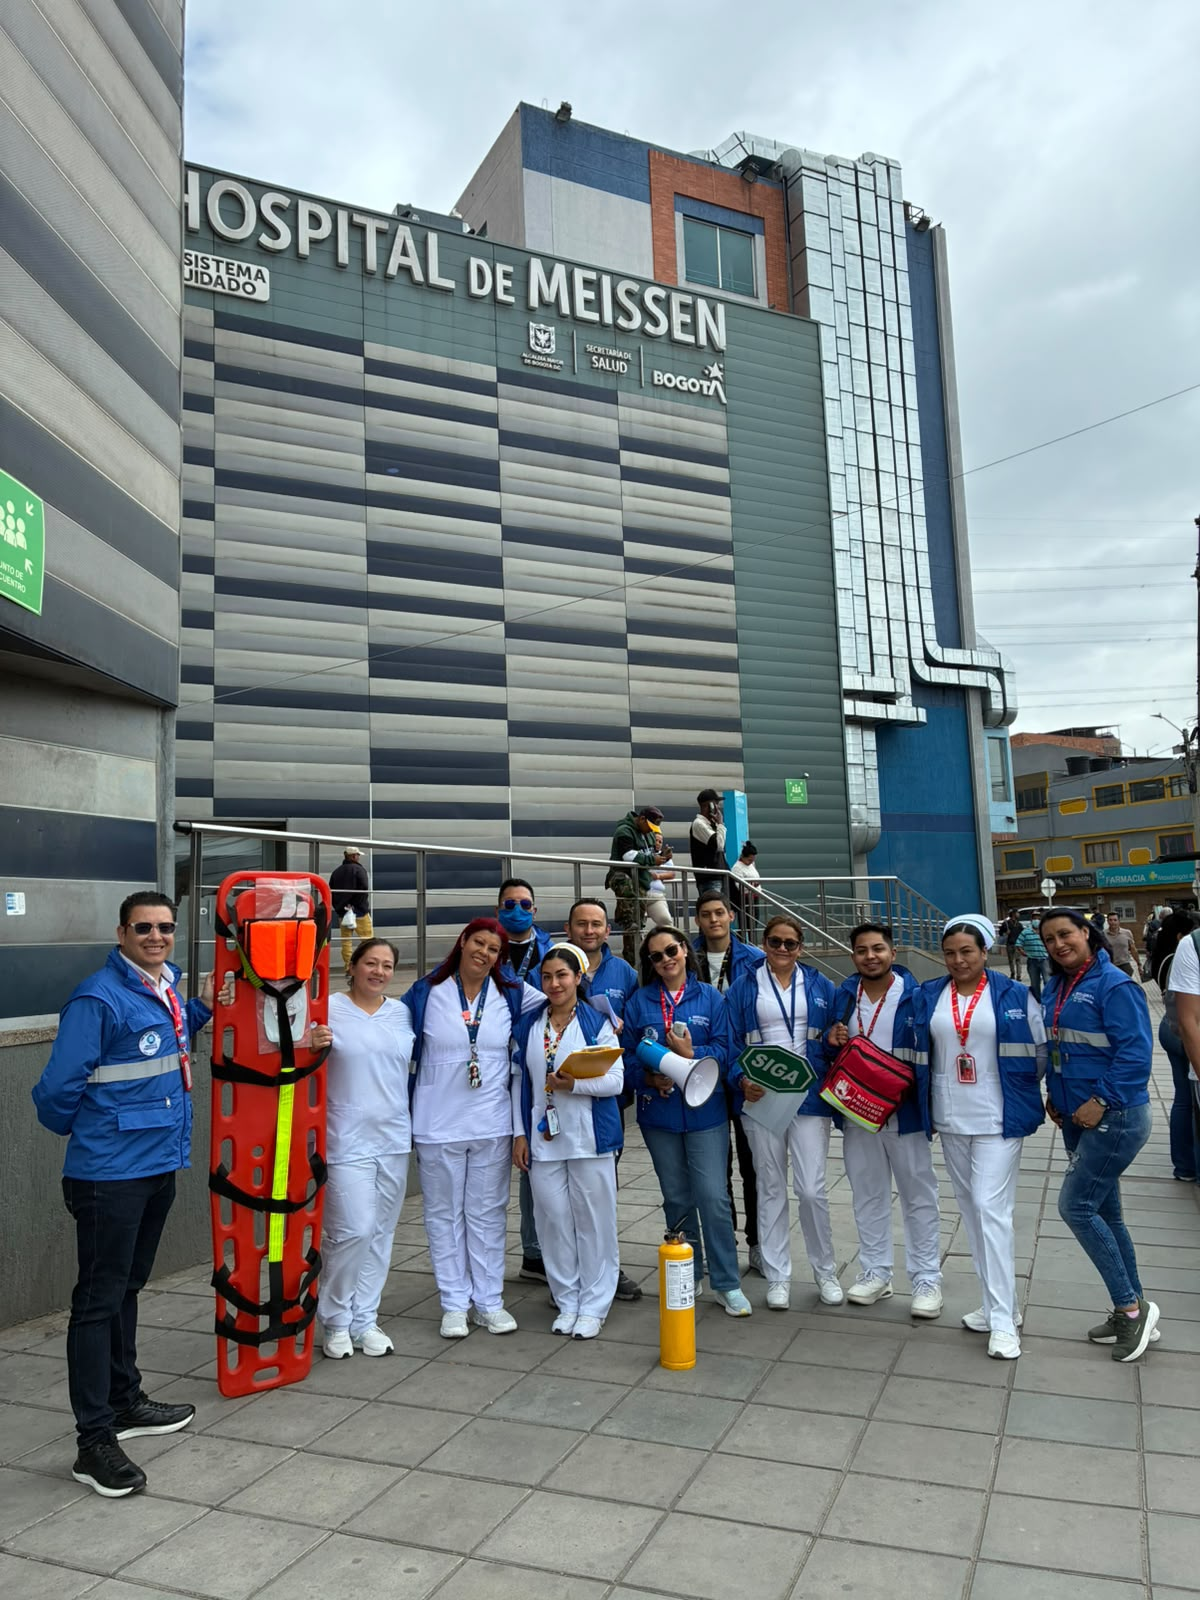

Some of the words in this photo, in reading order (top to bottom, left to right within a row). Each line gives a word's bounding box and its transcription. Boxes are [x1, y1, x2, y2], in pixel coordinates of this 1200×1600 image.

[184, 253, 266, 283] SISTEMA
[467, 256, 515, 306] DE
[528, 257, 727, 351] MEISSEN
[623, 351, 633, 360] DE
[591, 356, 628, 374] SALUD
[15, 569, 24, 581] DE
[1105, 874, 1146, 884] FARMACIA
[751, 1053, 800, 1086] SIGA
[852, 1098, 883, 1117] PRIMEROS
